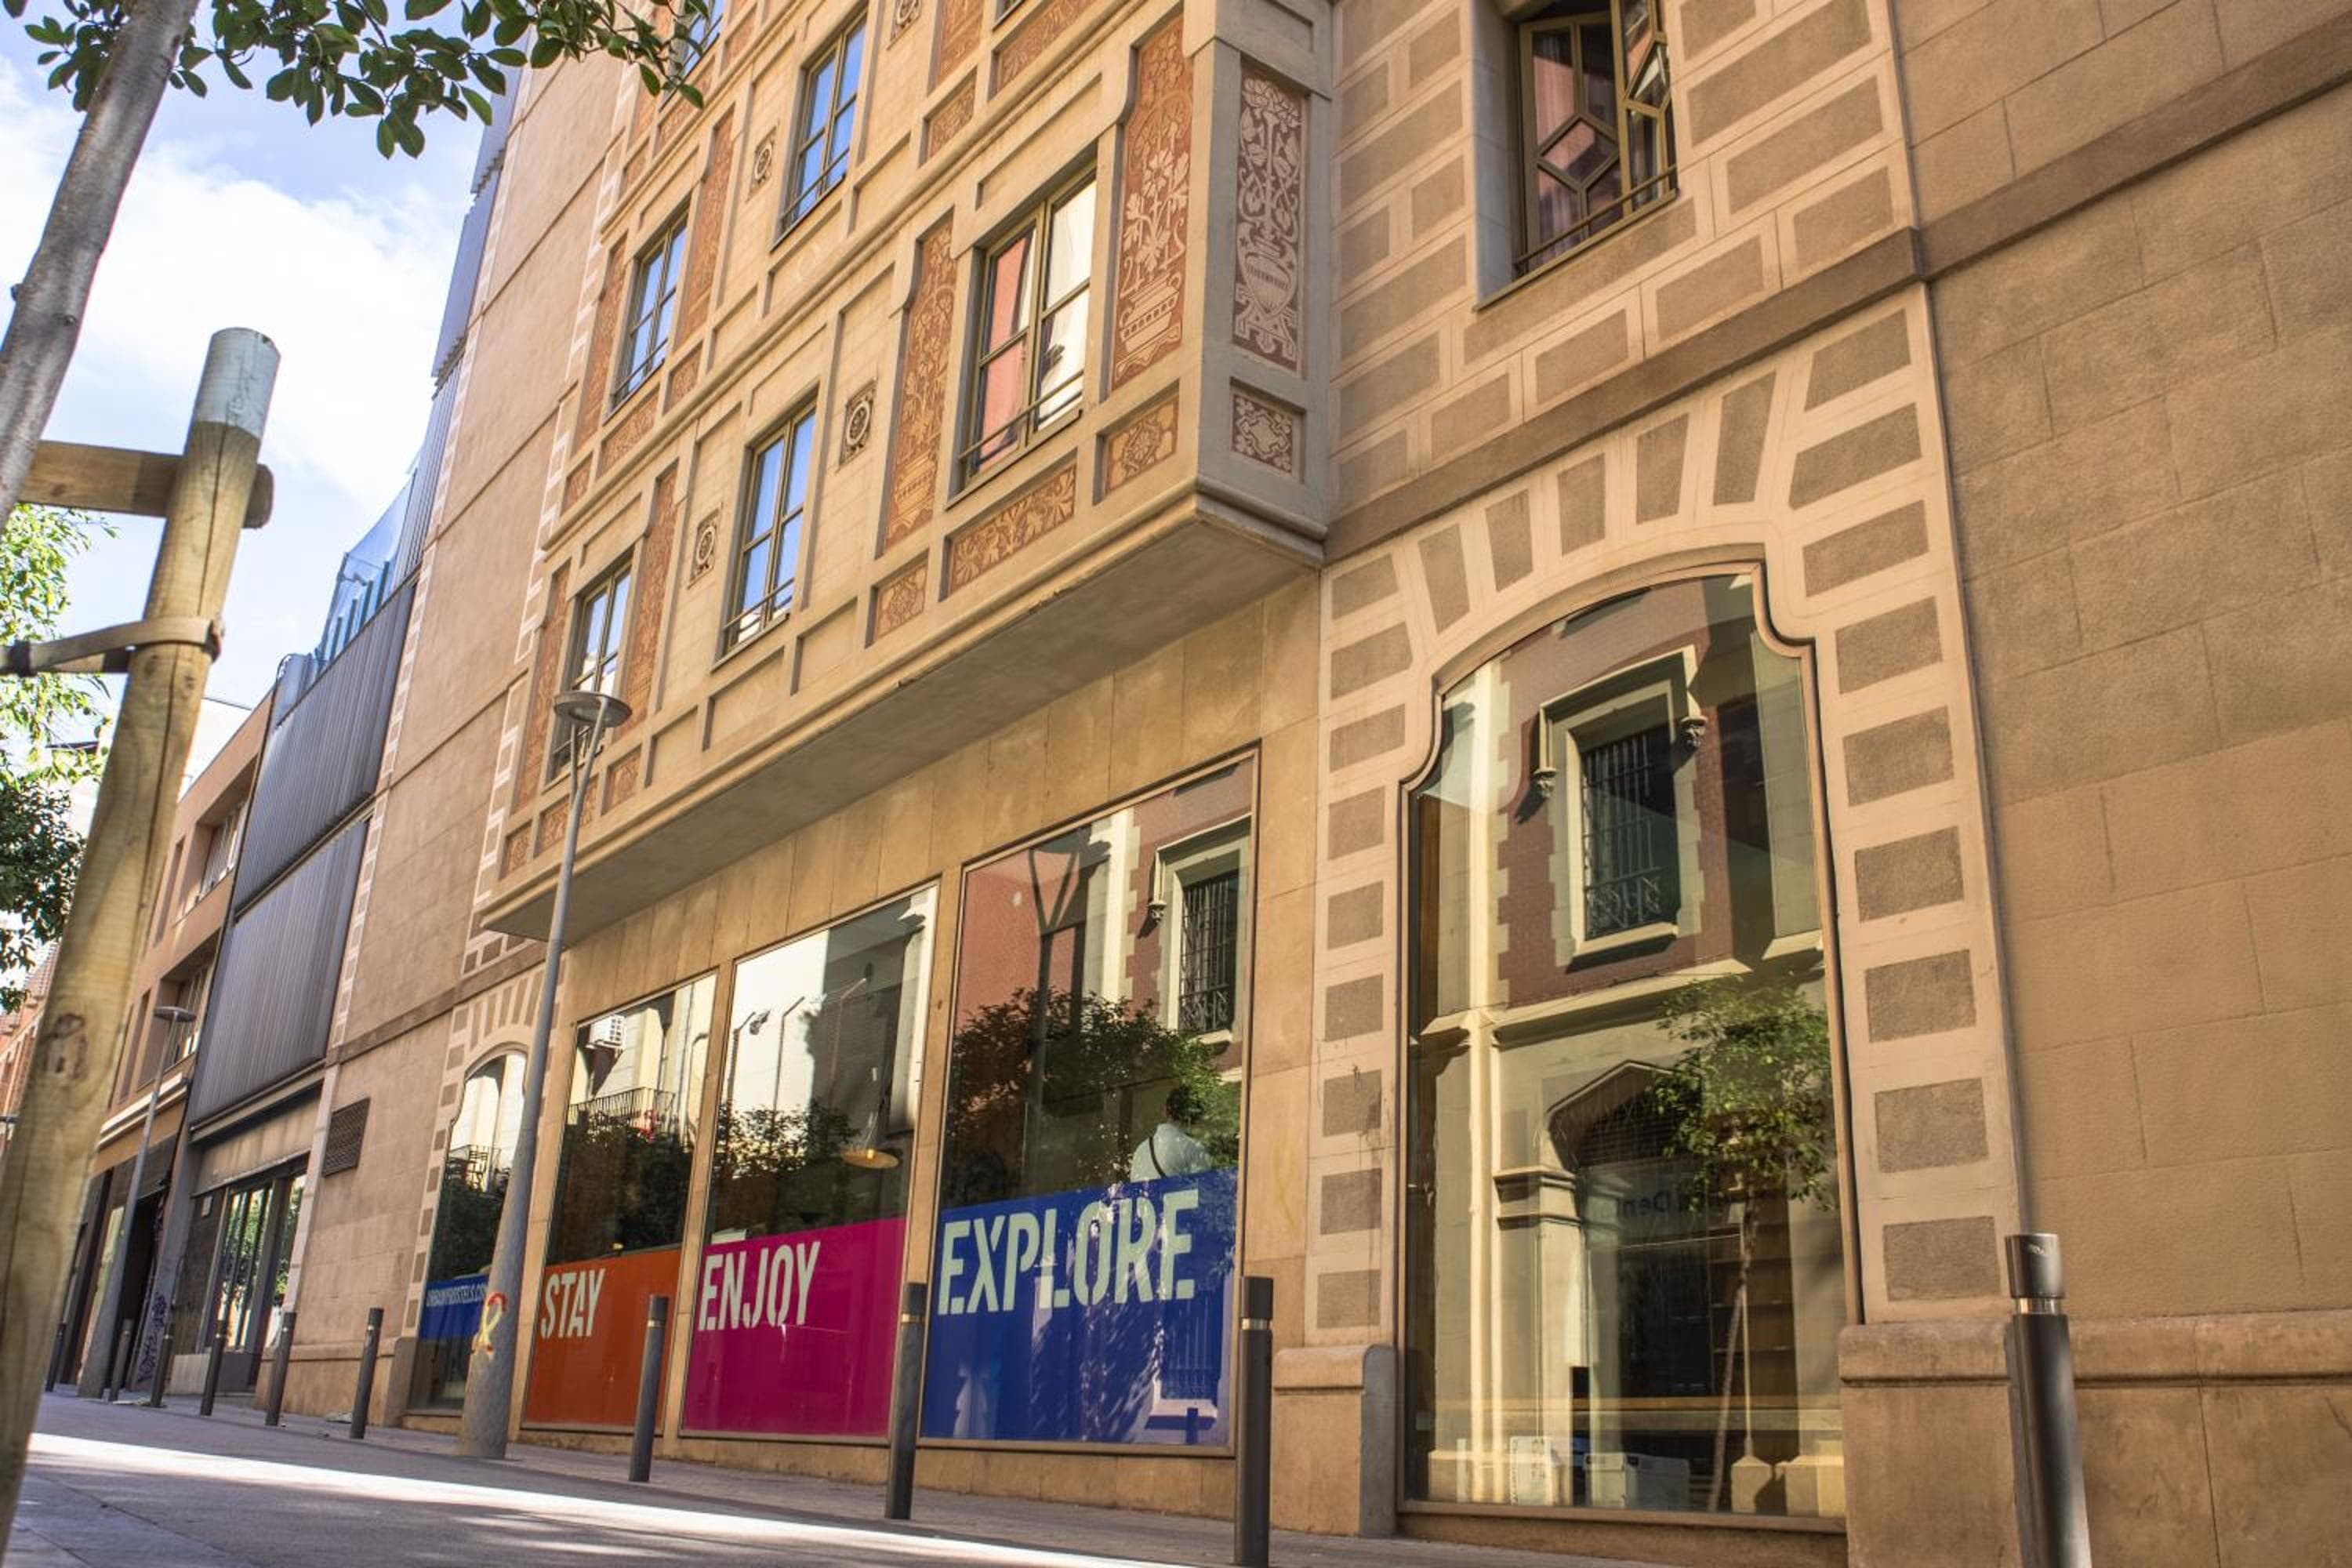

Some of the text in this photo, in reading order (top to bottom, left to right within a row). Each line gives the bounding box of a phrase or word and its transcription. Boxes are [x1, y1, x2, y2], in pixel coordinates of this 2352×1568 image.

[699, 1241, 820, 1330] ENJOY
[938, 1189, 1199, 1316] EXPLORE
[540, 1268, 606, 1339] STAY
